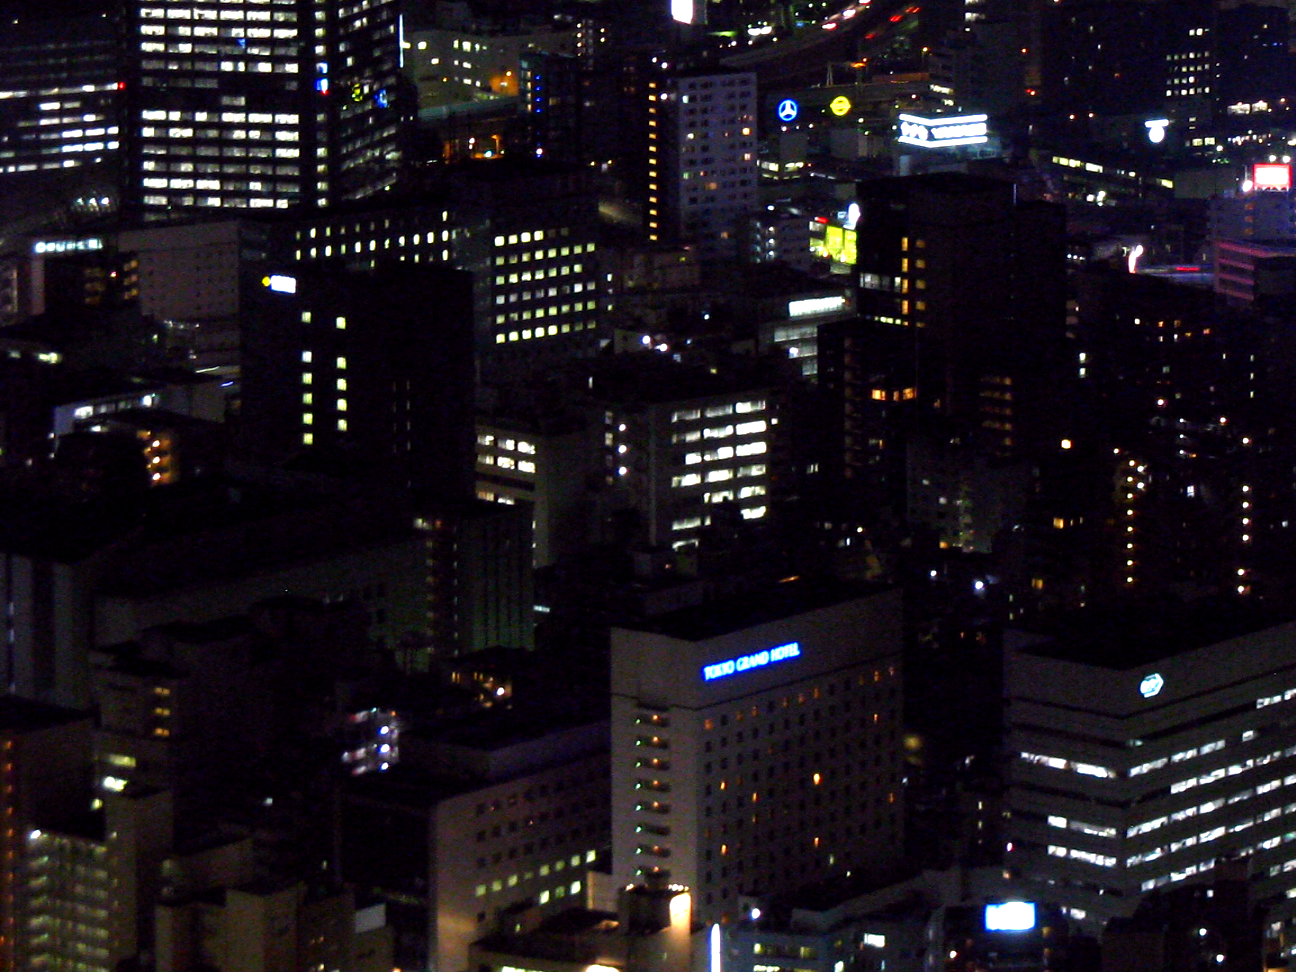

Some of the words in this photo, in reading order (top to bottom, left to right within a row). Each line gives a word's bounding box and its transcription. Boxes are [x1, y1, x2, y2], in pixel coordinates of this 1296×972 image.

[703, 660, 735, 681] TOKYO
[736, 651, 769, 671] GRAND
[770, 642, 800, 662] HOTEL
